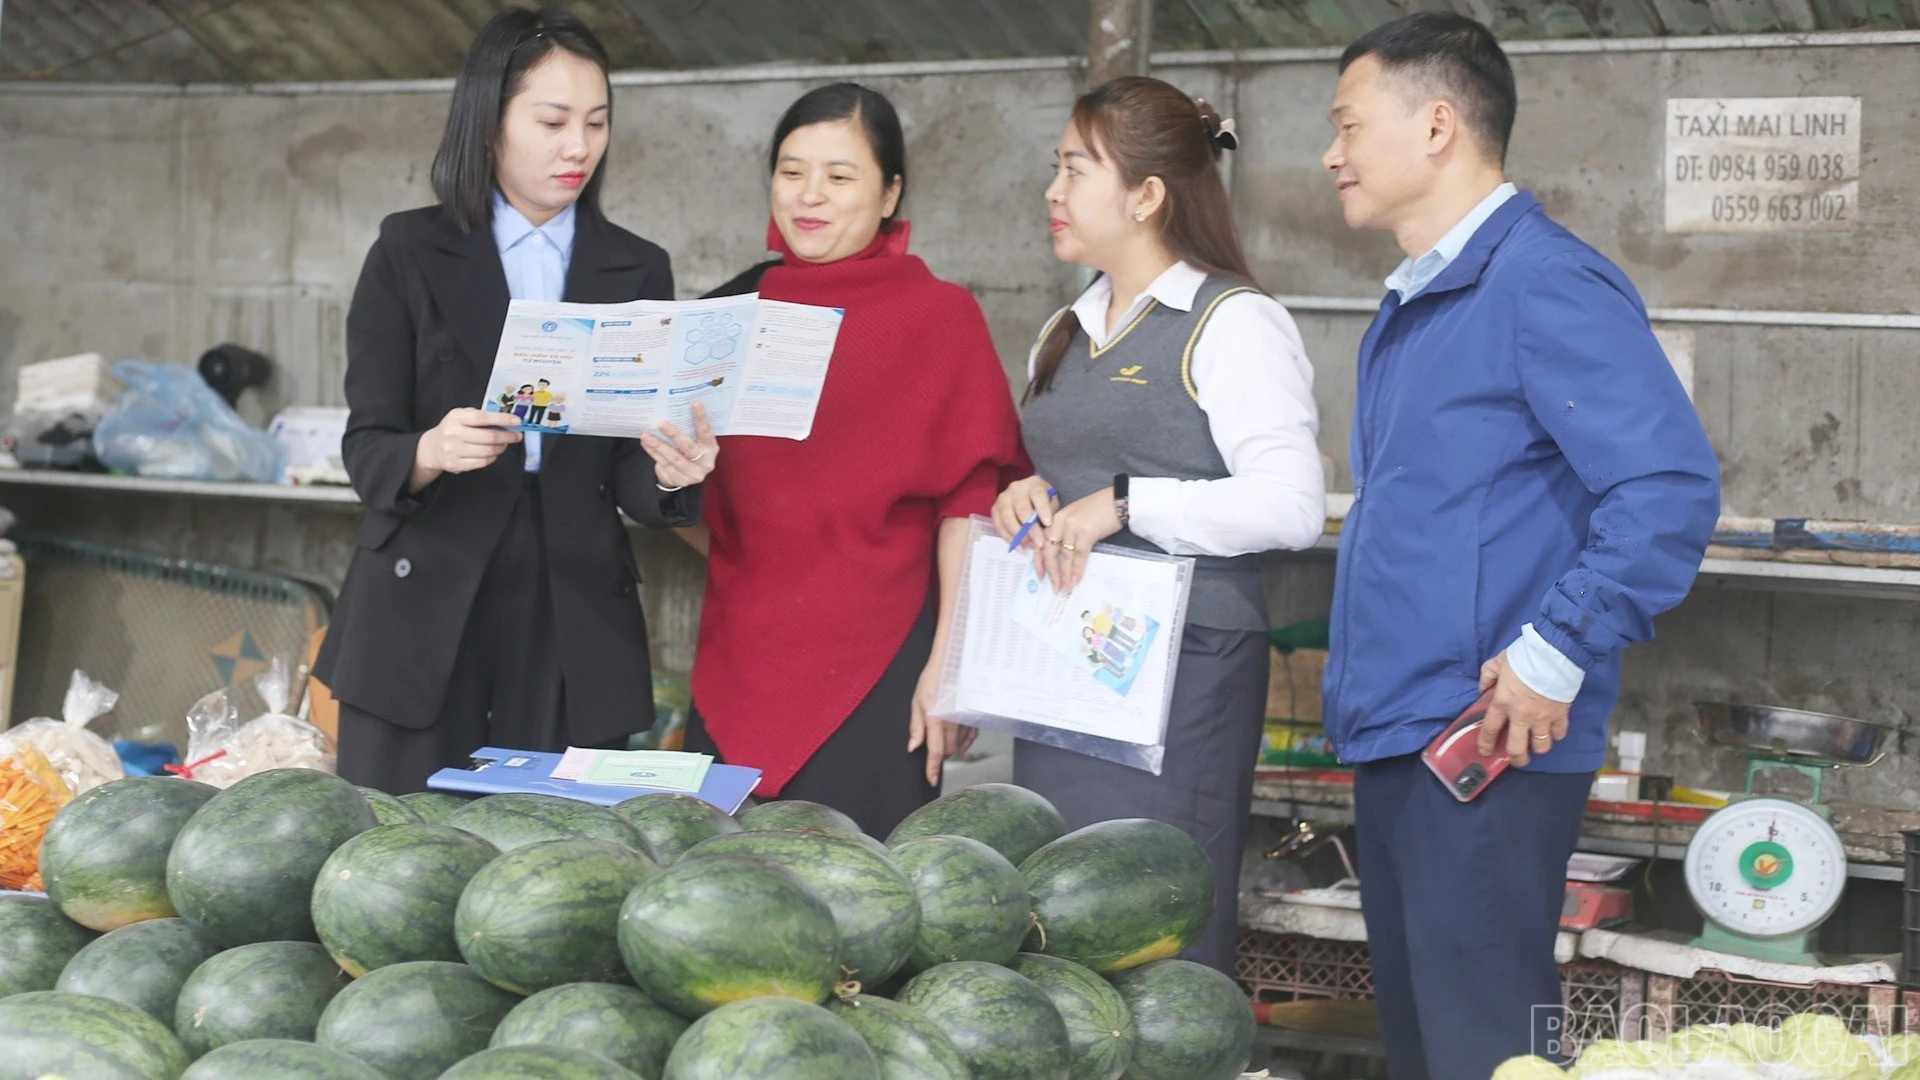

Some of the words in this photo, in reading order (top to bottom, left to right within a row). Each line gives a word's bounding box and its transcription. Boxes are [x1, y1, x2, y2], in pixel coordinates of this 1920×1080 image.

[1736, 114, 1781, 137] MAI
[1789, 113, 1847, 136] LINH
[1675, 155, 1702, 181] ĐT:
[1708, 154, 1757, 181] 0984
[1764, 154, 1801, 181] 959
[1807, 154, 1844, 181] 038
[1712, 195, 1760, 222] 0559
[1767, 195, 1802, 222] 663
[1810, 194, 1847, 222] 002
[1709, 881, 1722, 892] 10
[1800, 892, 1808, 902] 5
